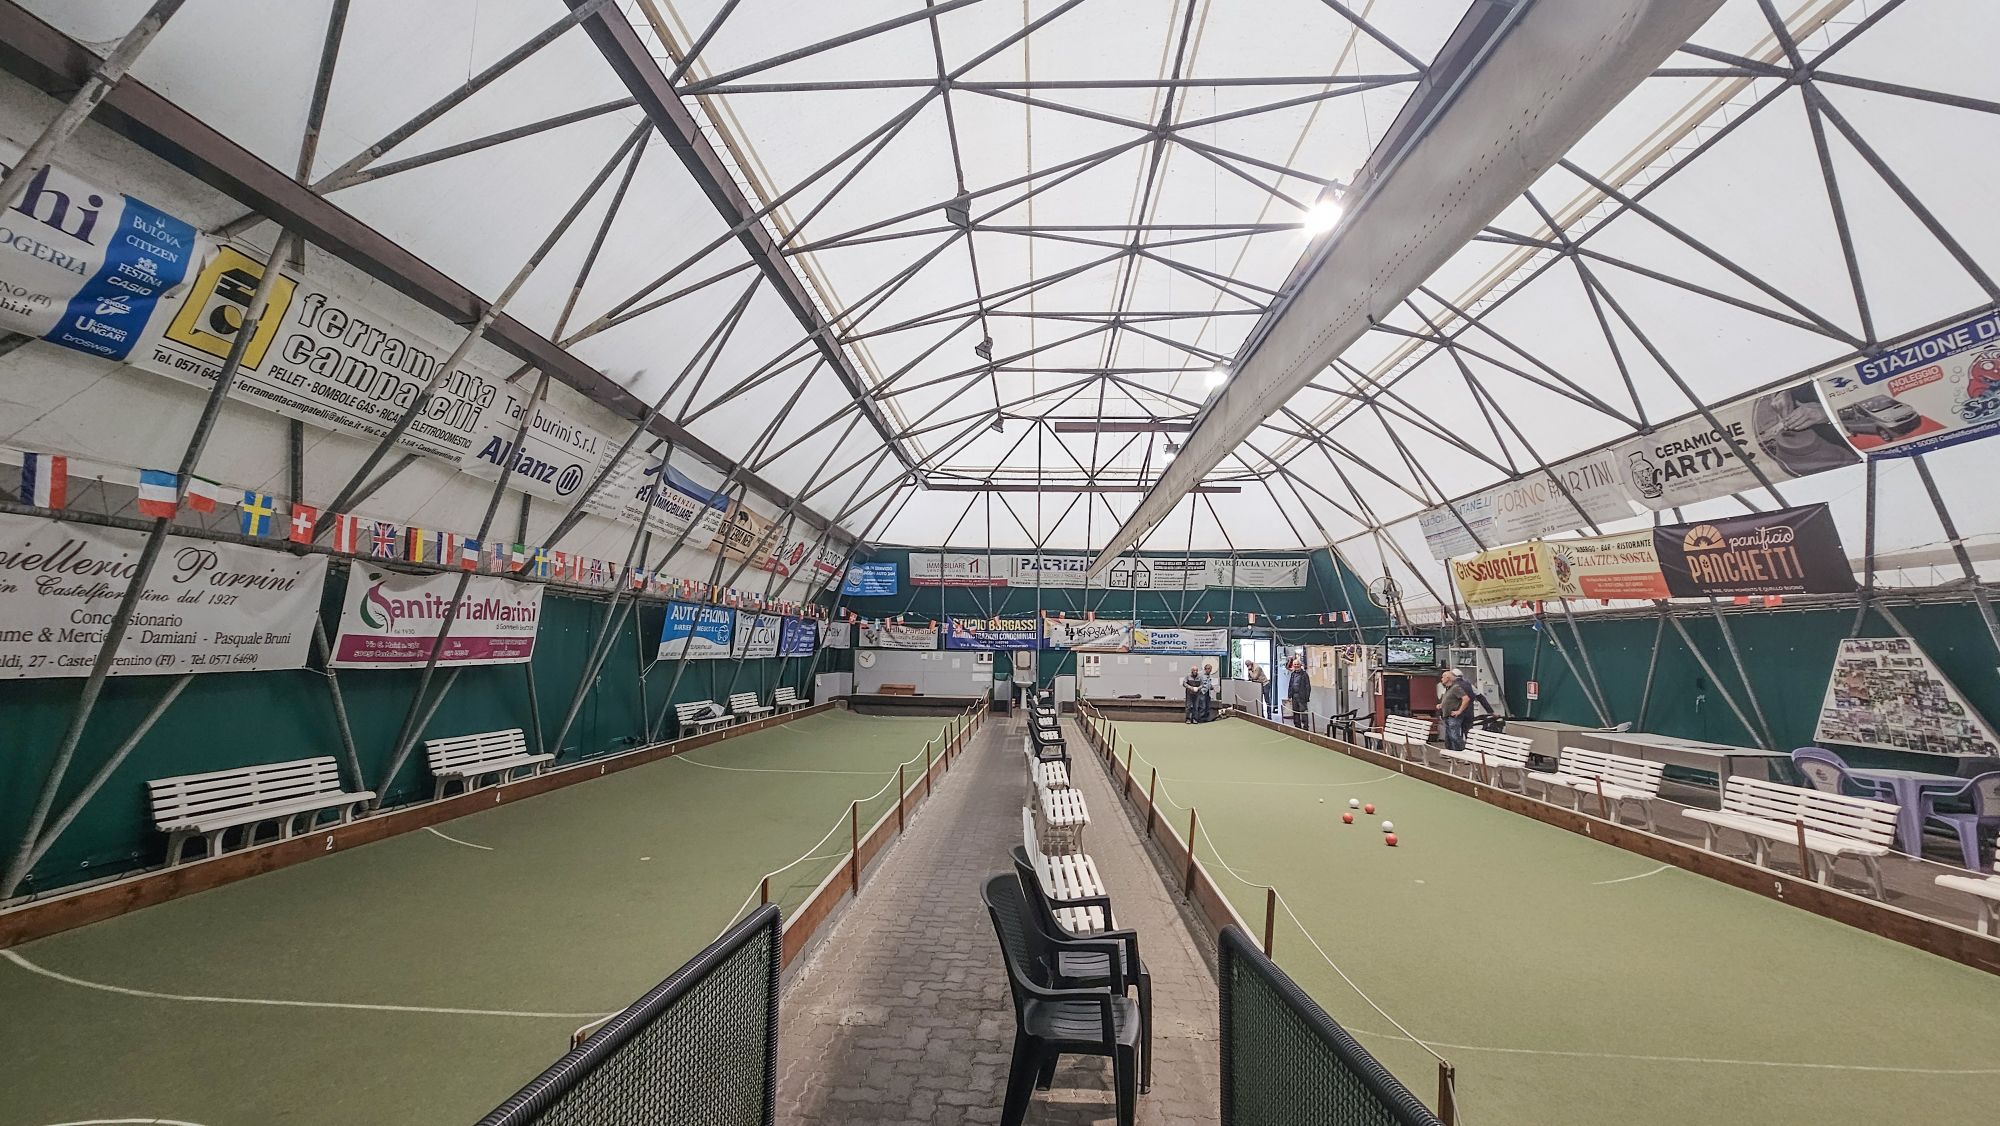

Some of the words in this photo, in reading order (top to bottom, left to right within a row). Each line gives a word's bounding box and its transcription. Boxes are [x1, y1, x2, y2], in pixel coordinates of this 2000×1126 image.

[132, 215, 182, 249] BULOVA
[126, 234, 180, 264] CITIZEN
[106, 276, 153, 296] CASIO
[117, 262, 163, 289] FESTINA
[93, 320, 128, 337] LORENZO
[151, 349, 173, 366] Tel.
[174, 357, 201, 375] 0571
[1861, 327, 1974, 380] STAZIONE
[1889, 367, 1940, 389] NOLEGGIO
[267, 364, 307, 388] PELLET
[310, 382, 357, 408] BOMBOLE
[355, 400, 377, 415] GAS
[1616, 538, 1652, 550] RISTORANTE
[1728, 525, 1796, 554] panificio
[1261, 560, 1302, 568] VENTURI
[1621, 551, 1655, 564] SOSTA
[1685, 546, 1805, 584] PANCHETTI
[171, 546, 301, 592] Parrini
[176, 590, 205, 605] dal
[207, 593, 239, 606] 1927
[37, 627, 55, 643] &
[139, 629, 197, 645] Damiani
[213, 631, 263, 648] Pasquale
[263, 632, 292, 645] Bruni
[28, 654, 48, 668] 27
[155, 653, 176, 668] (FI)
[190, 654, 206, 665] Tel.
[208, 653, 232, 666] 0571
[325, 835, 334, 851] 2
